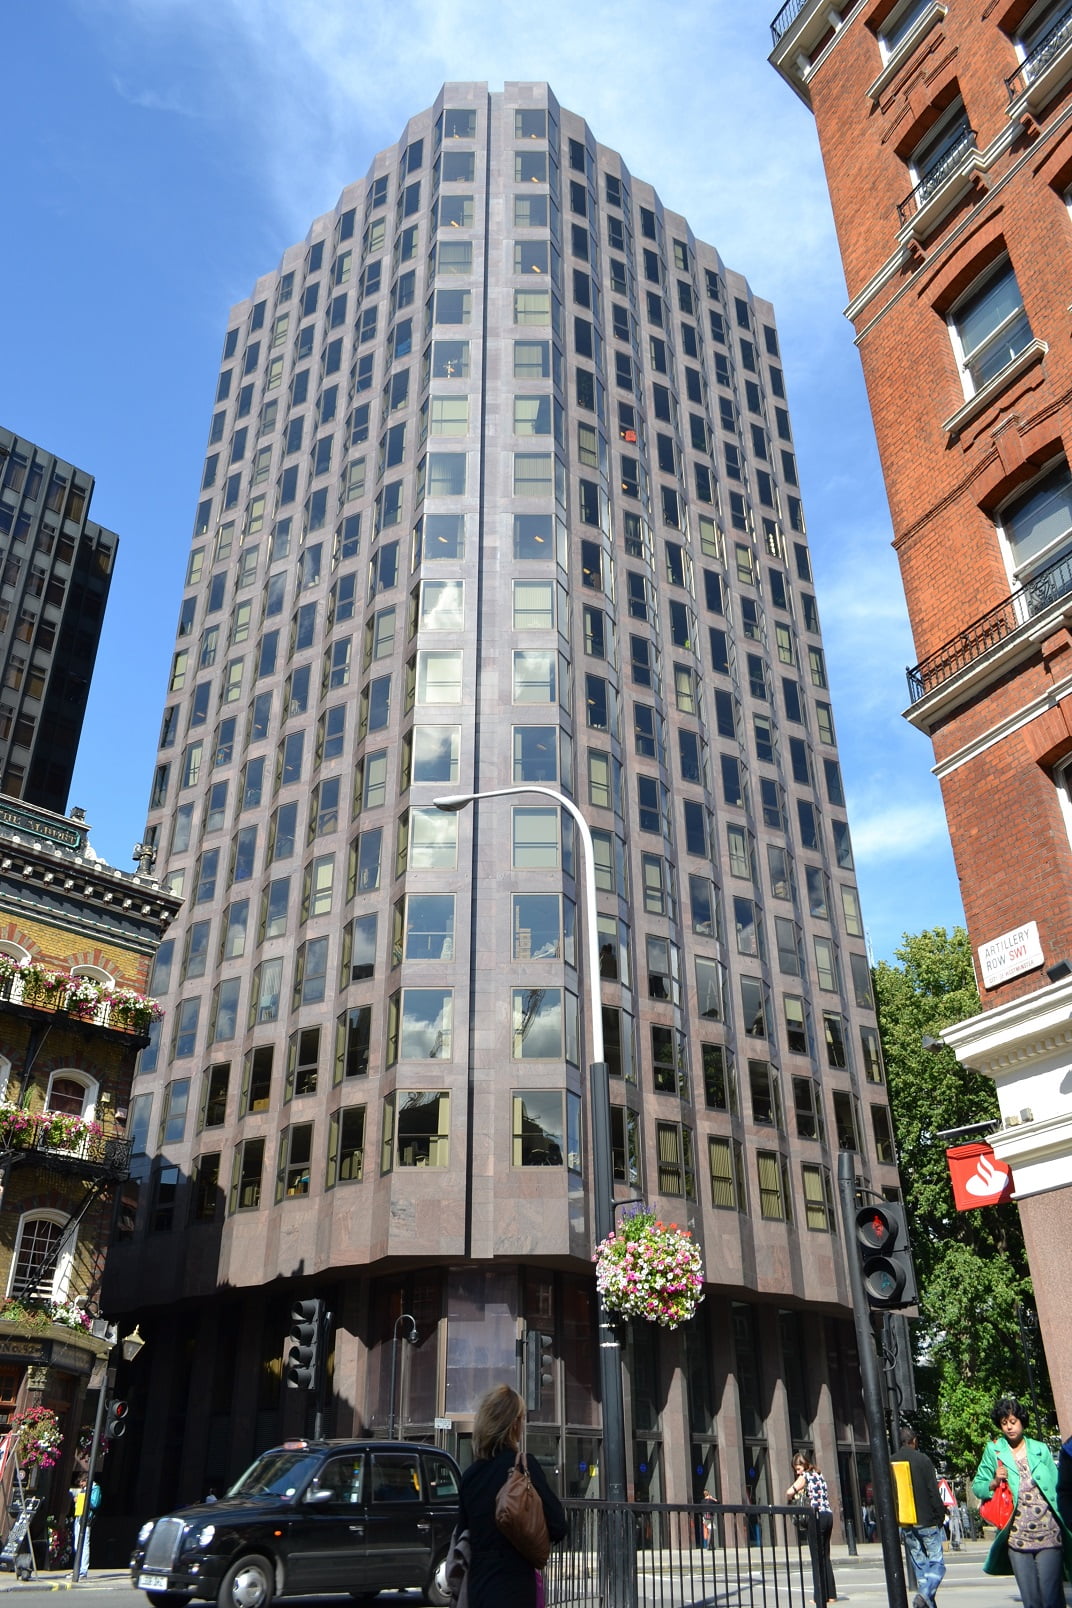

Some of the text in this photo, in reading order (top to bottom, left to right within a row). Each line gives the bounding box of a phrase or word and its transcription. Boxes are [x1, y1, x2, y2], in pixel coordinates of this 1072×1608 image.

[985, 929, 1029, 959] ARTILLERY
[986, 945, 1027, 971] ROW SW1
